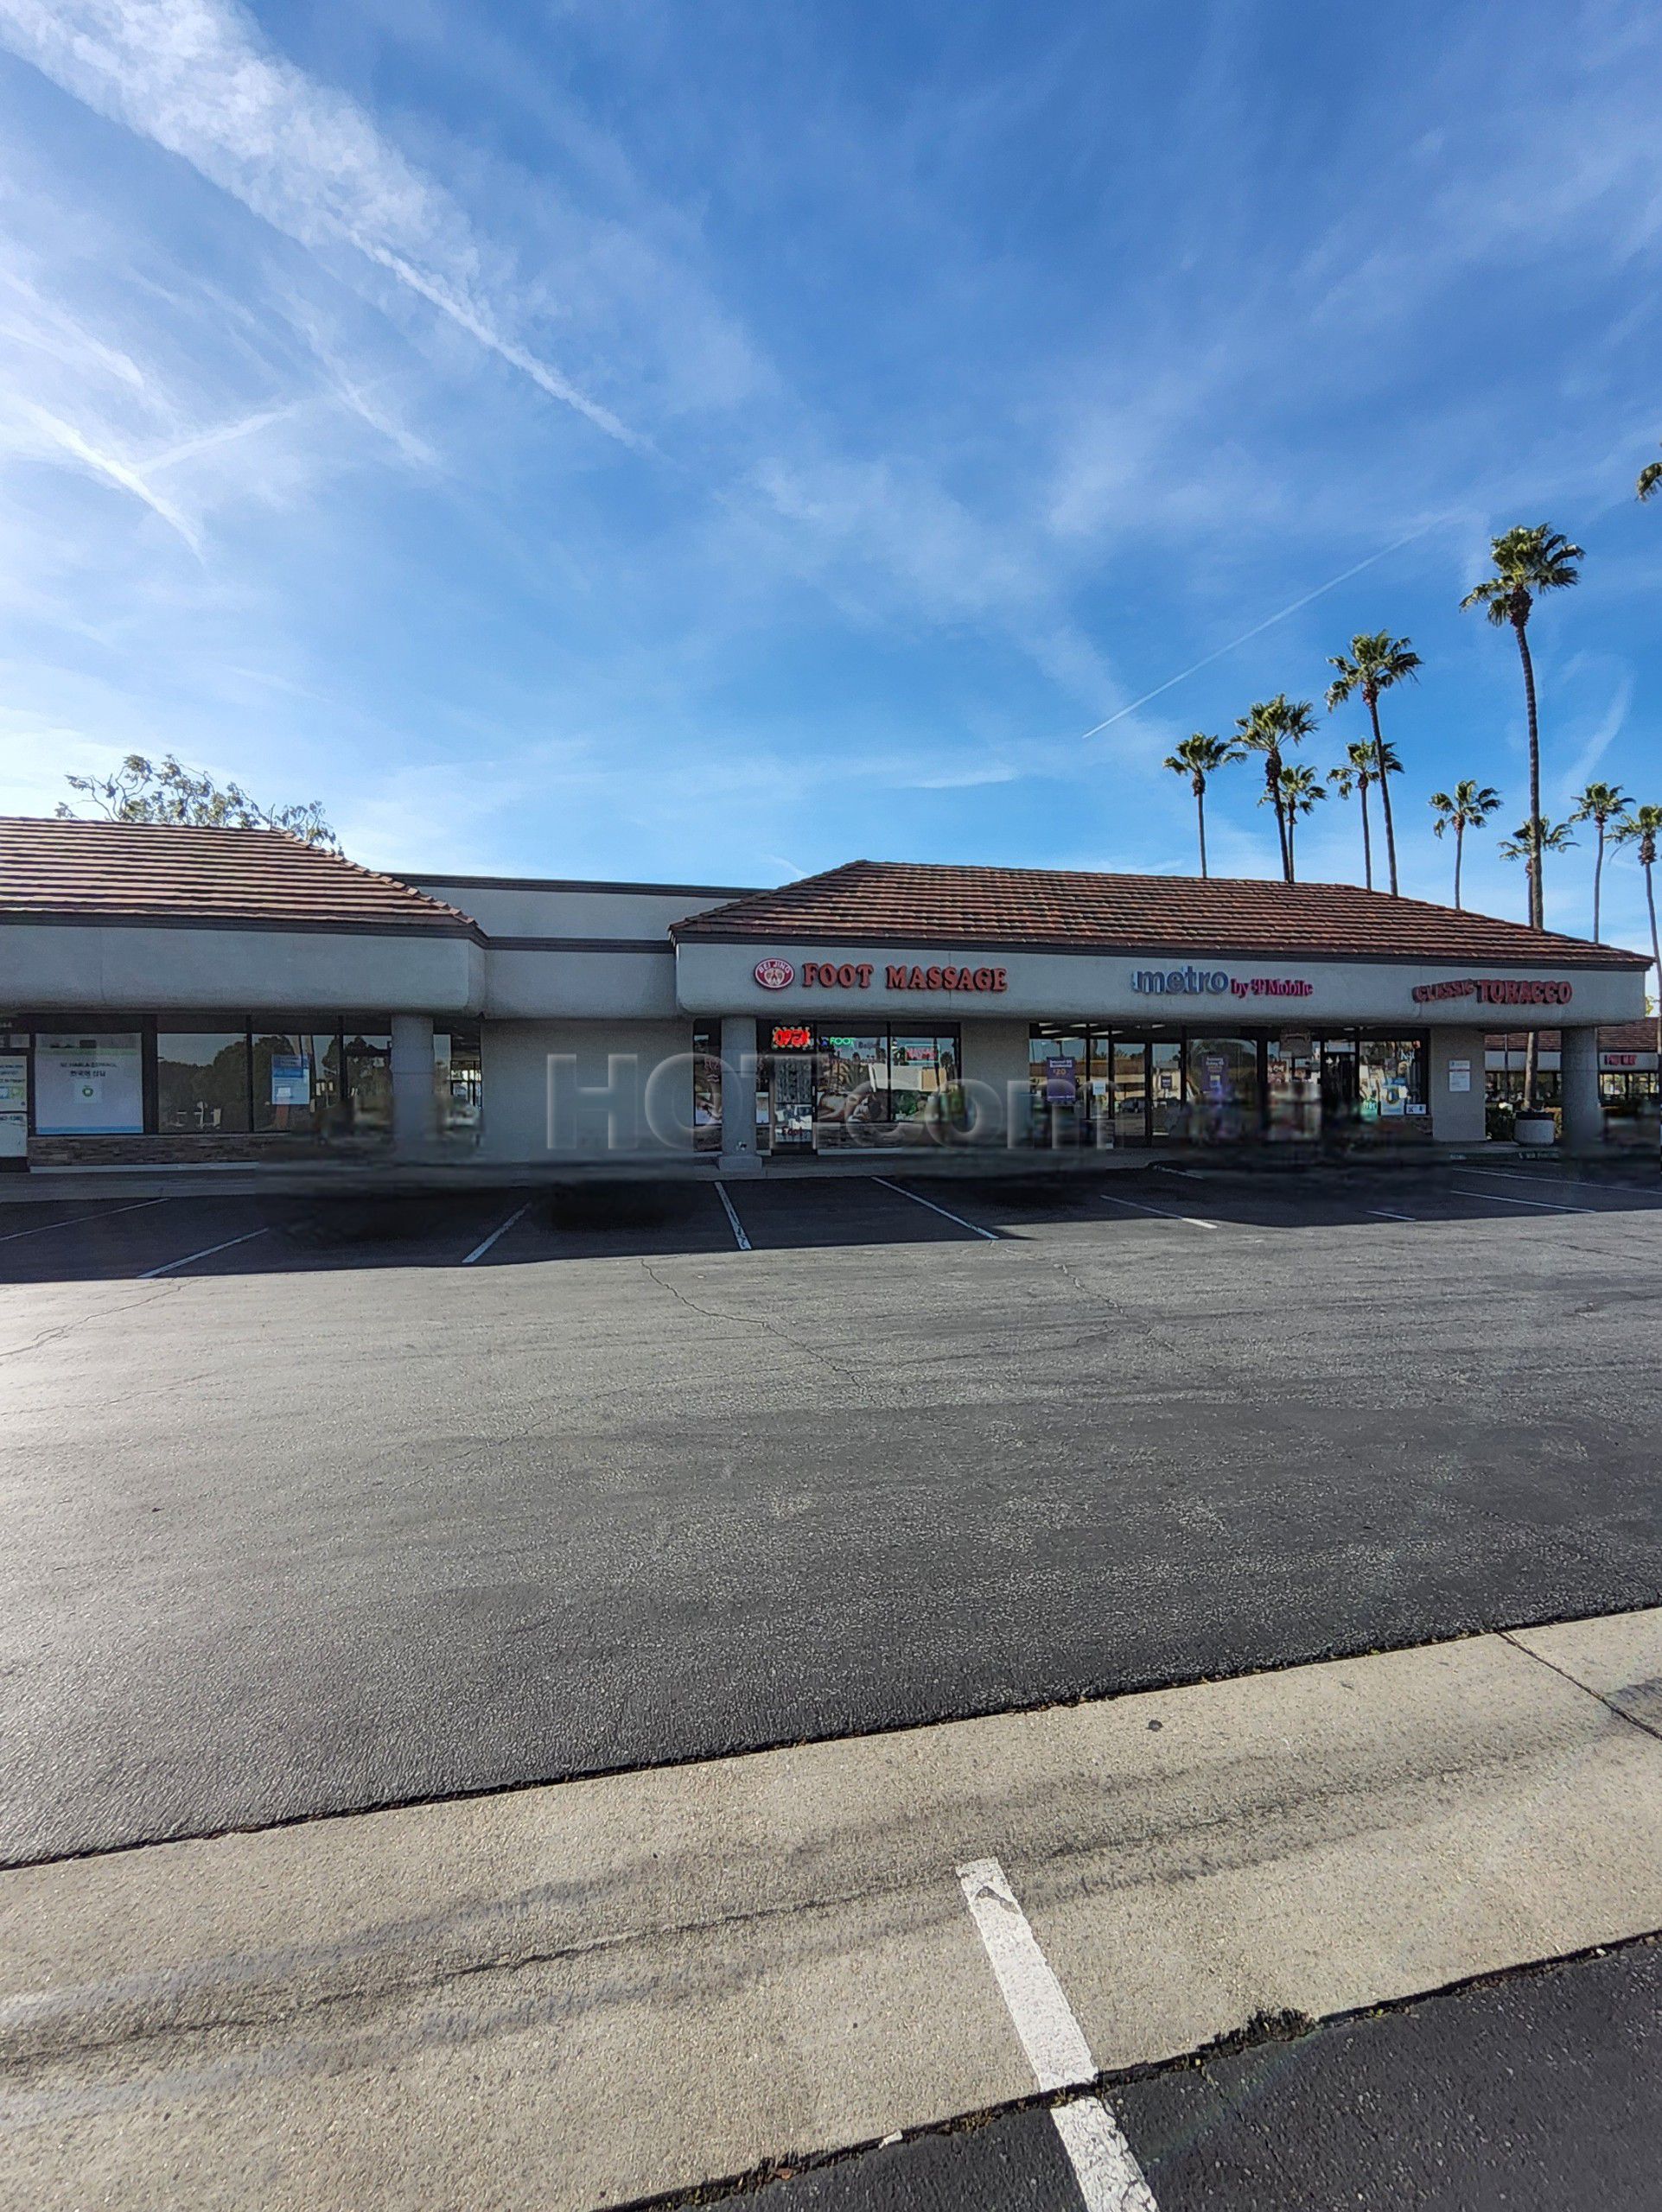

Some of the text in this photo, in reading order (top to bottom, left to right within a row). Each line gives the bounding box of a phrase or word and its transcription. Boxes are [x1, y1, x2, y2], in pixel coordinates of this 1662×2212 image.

[801, 963, 1009, 992] FOOT MASSAGE
[1131, 965, 1229, 995] metro
[1231, 978, 1250, 998] by
[1412, 980, 1572, 1005] CLASSIC TOBACCO
